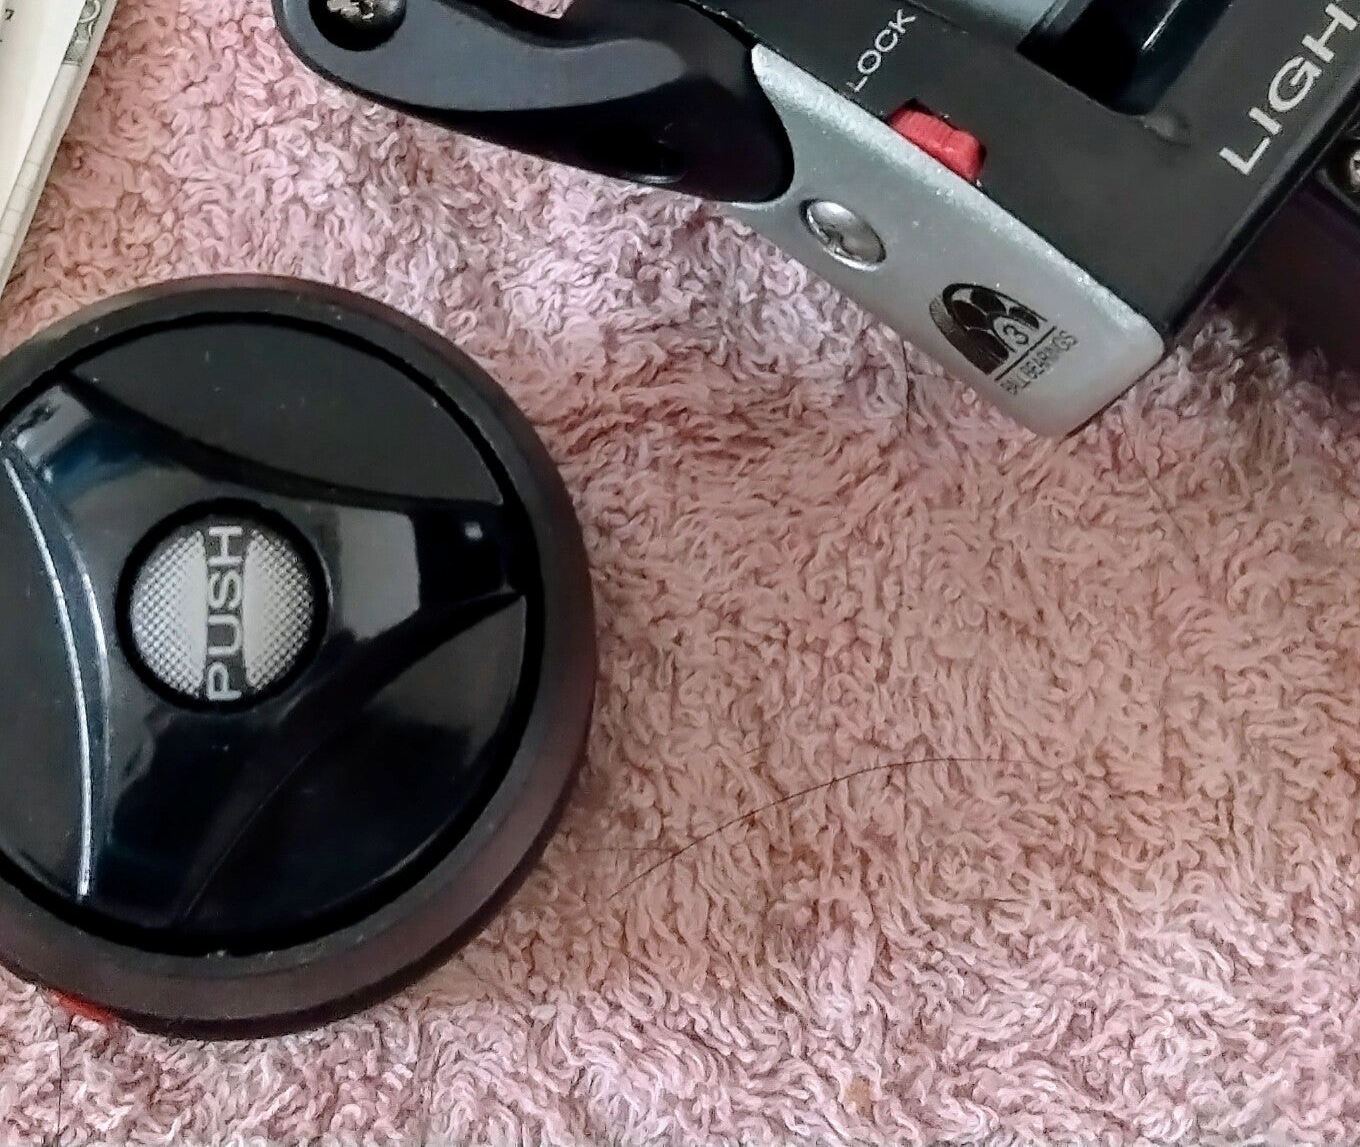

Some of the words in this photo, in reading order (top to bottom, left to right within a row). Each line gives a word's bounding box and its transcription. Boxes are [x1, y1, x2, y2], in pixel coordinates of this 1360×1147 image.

[846, 8, 918, 93] LOCK
[1002, 323, 1030, 346] 3
[204, 524, 244, 703] PUSH
